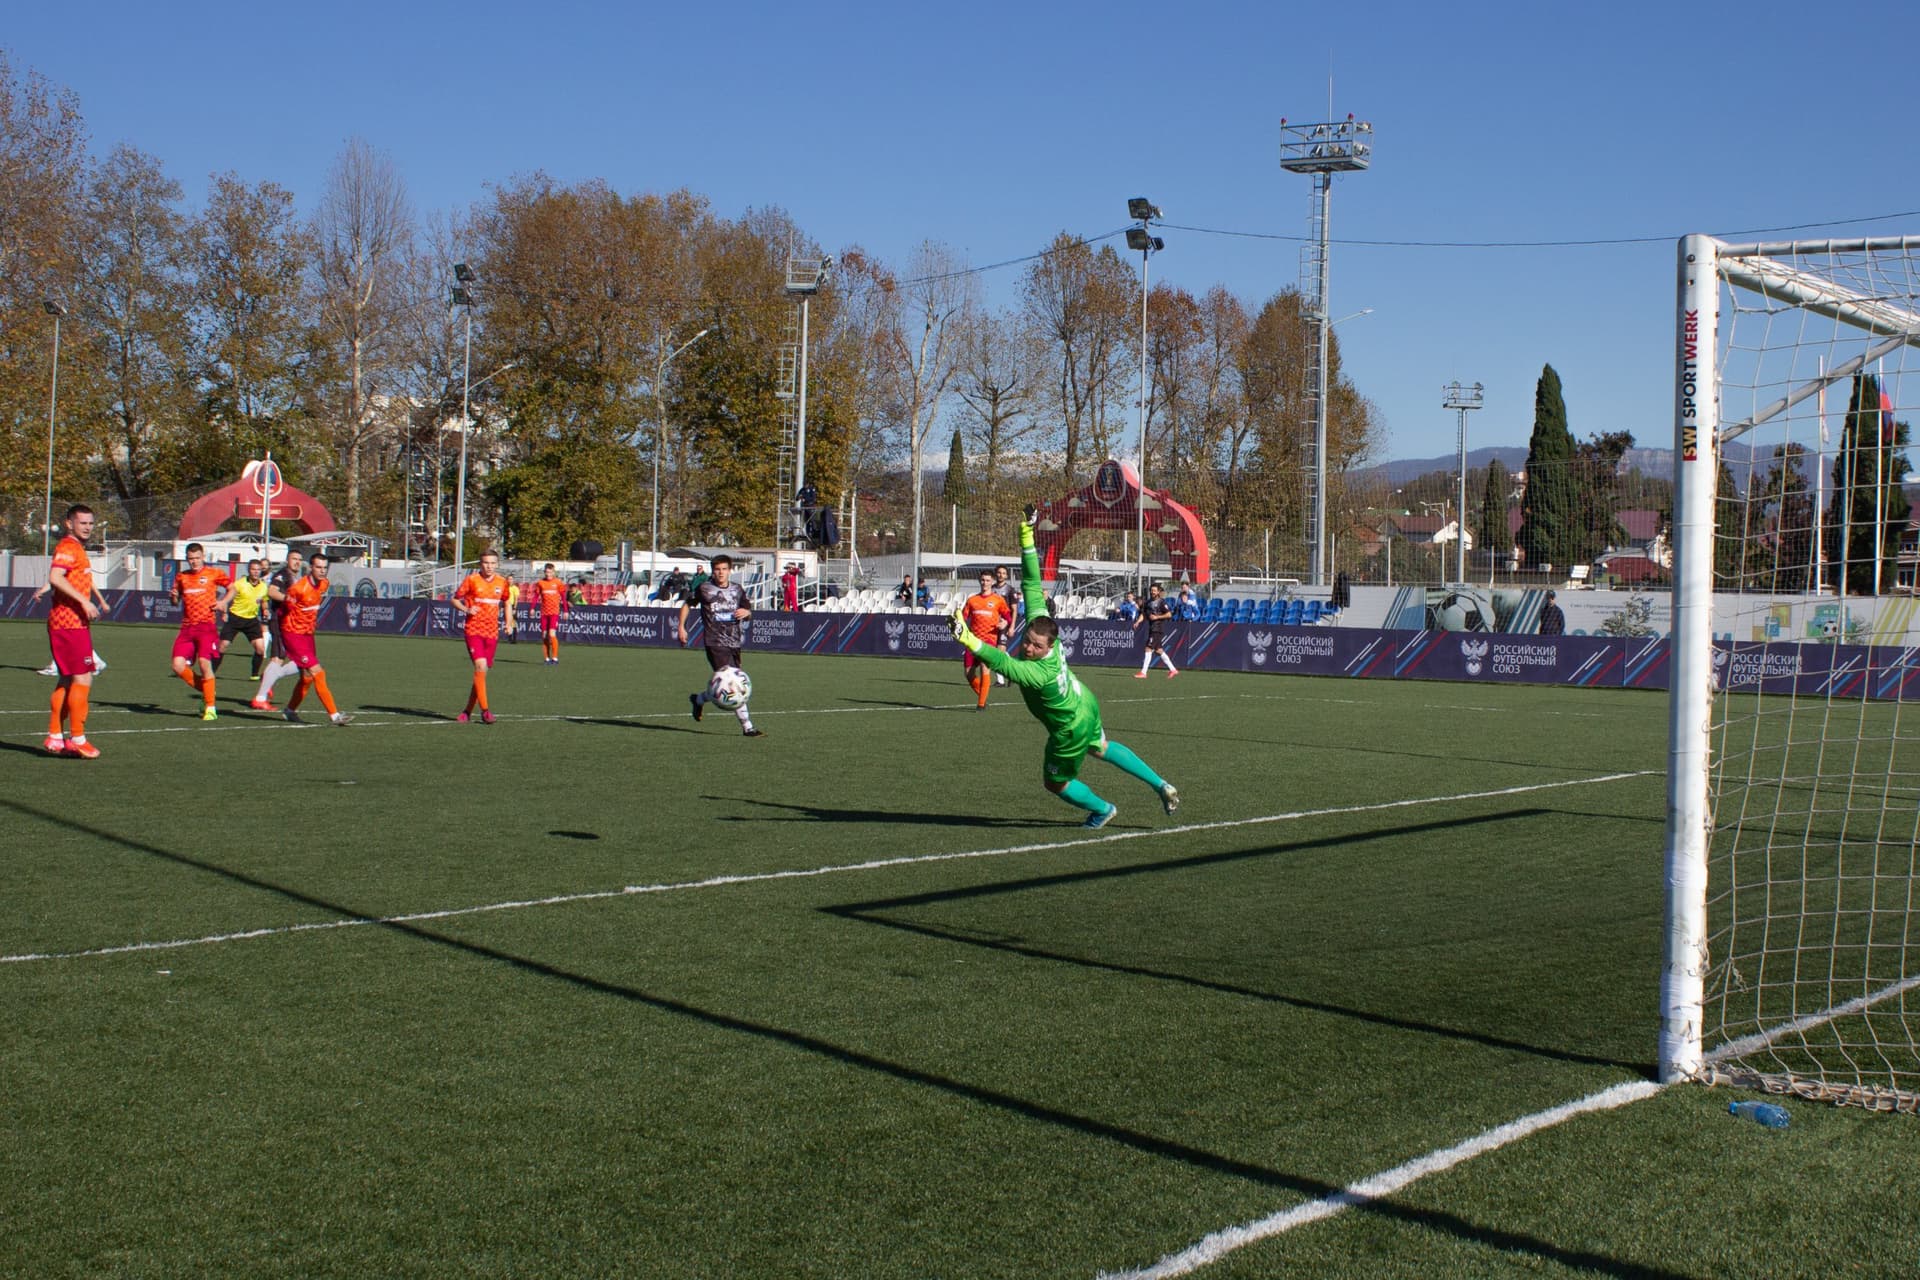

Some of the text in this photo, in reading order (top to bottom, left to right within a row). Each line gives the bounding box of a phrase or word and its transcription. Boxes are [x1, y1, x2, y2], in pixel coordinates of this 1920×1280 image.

[1683, 309, 1698, 418] SPORTWERK
[601, 613, 614, 622] ПО
[616, 614, 657, 624] ФУТБОЛУ
[752, 635, 771, 644] СОЮЗ
[1083, 629, 1134, 639] РОССИЙСКИЙ
[907, 641, 928, 649] СОЮЗ
[1083, 638, 1134, 648] ФУТБОЛЬНЫЙ
[1277, 635, 1334, 647] РОССИЙСКИЙ
[1082, 647, 1105, 656] СОЮЗ
[1276, 645, 1334, 656] ФУТБОЛЬНЫЙ
[1493, 644, 1557, 656] РОССИЙСКИЙ
[1276, 654, 1301, 664] СОЮЗ
[1493, 654, 1557, 666] ФУТБОЛЬНЫЙ
[1492, 663, 1521, 674] СОЮЗ
